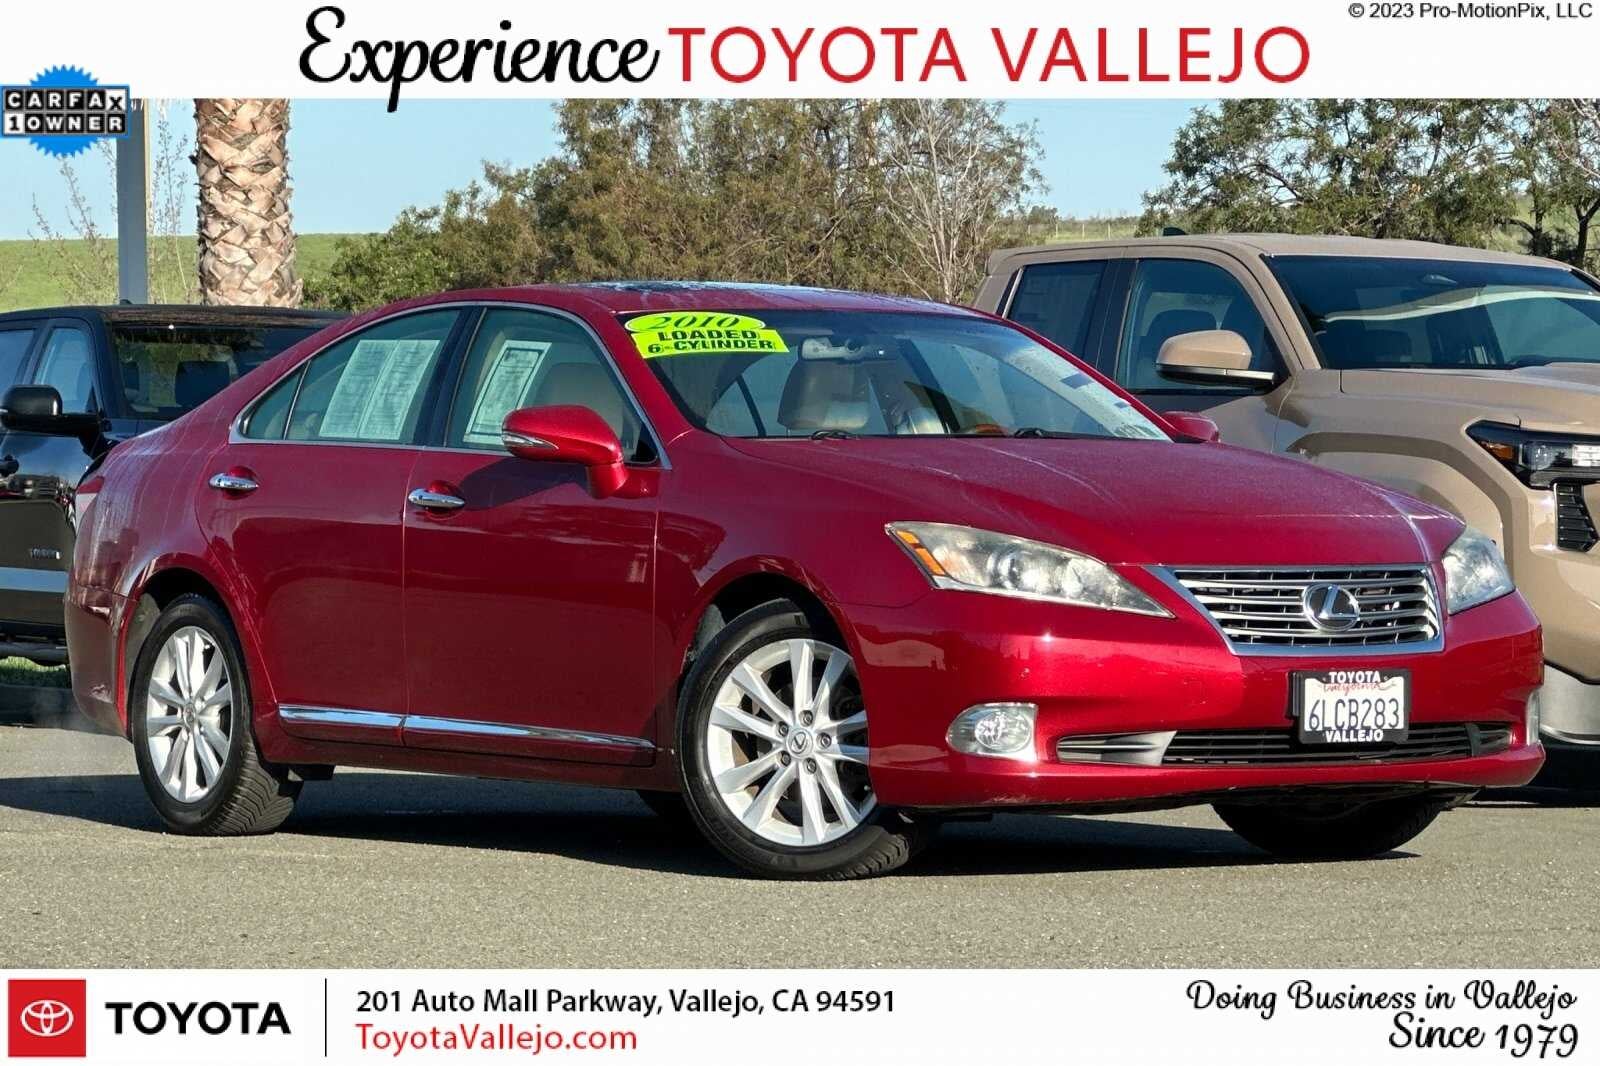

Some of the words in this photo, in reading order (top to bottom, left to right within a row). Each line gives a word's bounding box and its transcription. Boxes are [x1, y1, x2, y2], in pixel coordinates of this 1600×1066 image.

[650, 316, 740, 329] 2010
[658, 330, 759, 342] LOADED
[648, 339, 774, 354] 6-CYLINDER
[1328, 671, 1381, 683] TOYOTA
[1309, 698, 1399, 730] 6LCB283
[1325, 729, 1384, 742] VALLEJO
